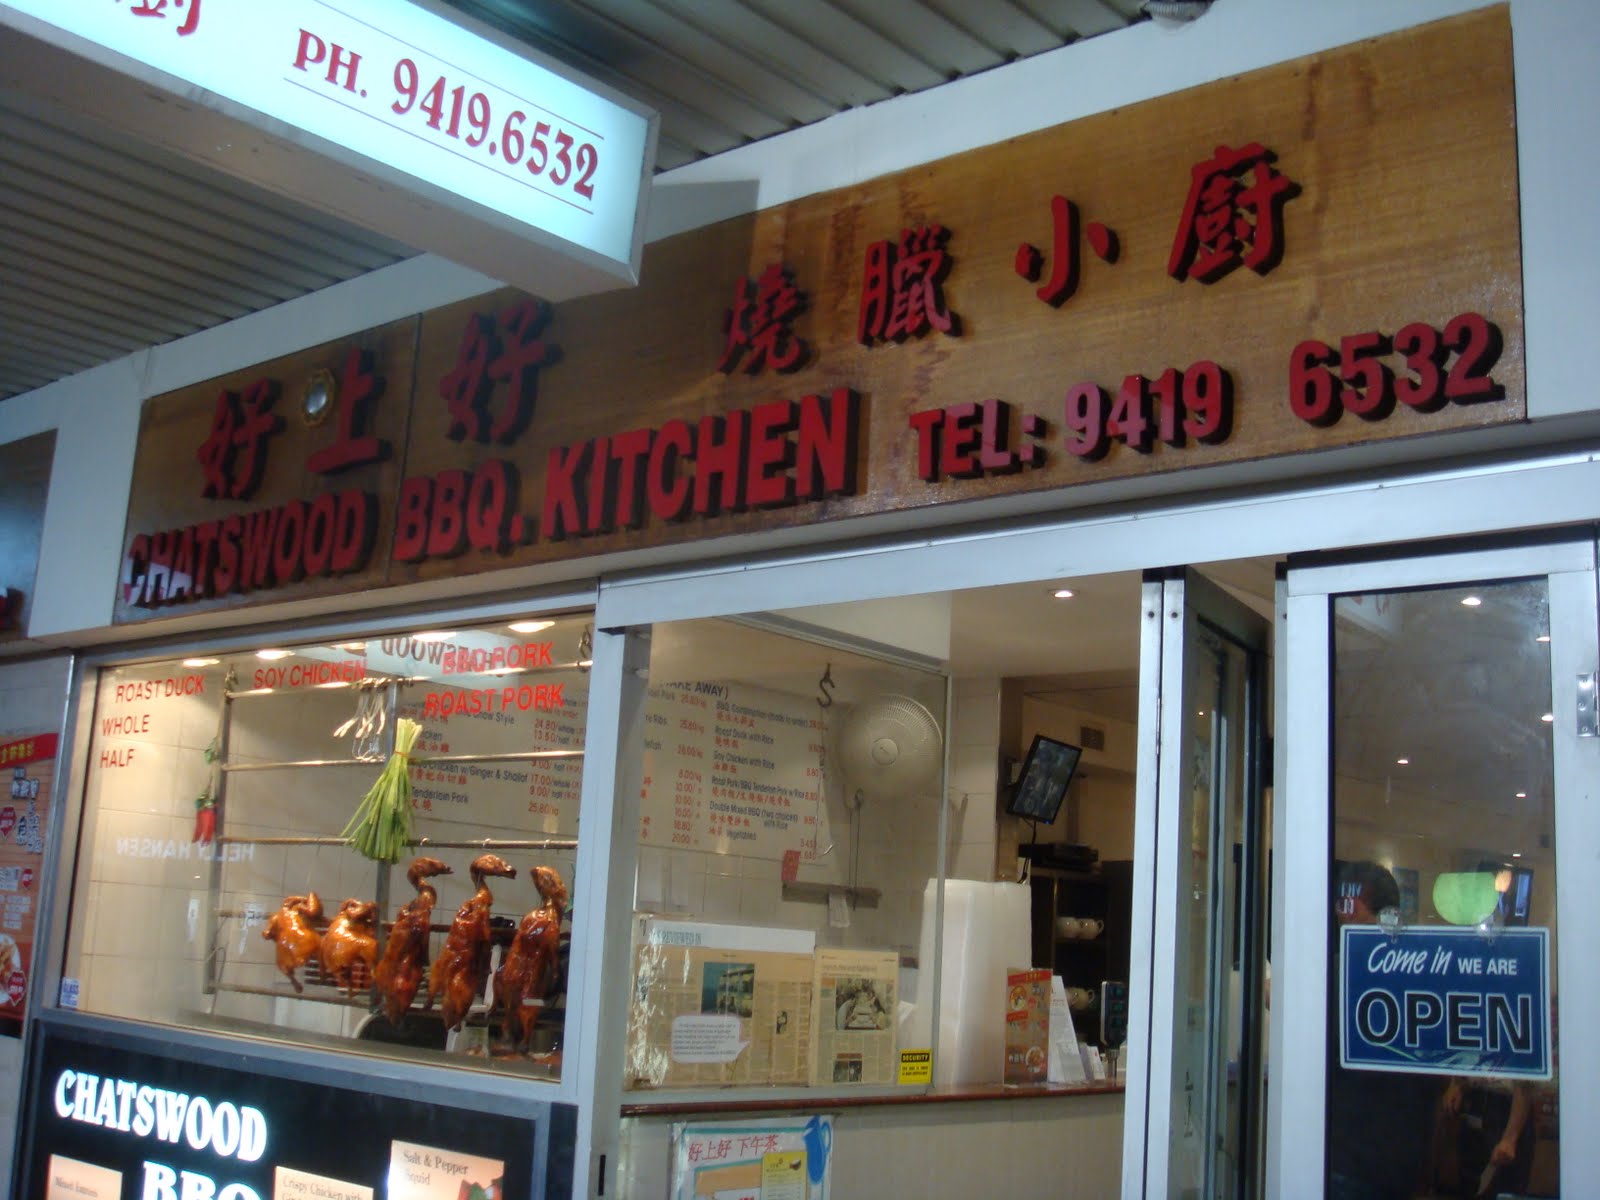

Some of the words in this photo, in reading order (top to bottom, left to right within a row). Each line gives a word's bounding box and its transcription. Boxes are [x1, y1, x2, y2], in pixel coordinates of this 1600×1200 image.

[292, 28, 367, 98] PH.
[391, 58, 599, 200] 9419.6532
[122, 488, 370, 607] CHATSWOOD
[392, 458, 525, 561] BBQ.
[543, 387, 851, 537] KITCHEN
[908, 399, 1038, 480] TEL:
[1064, 360, 1225, 457] 9419
[1288, 311, 1496, 421] 6532
[441, 647, 488, 675] BBQ
[489, 641, 553, 669] PORK
[115, 680, 162, 703] ROAST
[164, 674, 206, 697] DUCK
[253, 668, 287, 689] SOY
[289, 659, 367, 687] CHICKEN
[422, 688, 497, 718] ROAST
[501, 682, 565, 711] PORK
[694, 681, 730, 700] AWAY)
[102, 713, 151, 737] WHOLE
[100, 748, 135, 769] HALF
[1368, 942, 1427, 974] Come
[1430, 945, 1453, 976] in
[1457, 958, 1482, 975] WE
[1486, 958, 1518, 976] ARE
[1355, 987, 1533, 1055] OPEN
[54, 1069, 268, 1163] CHATSWOOD
[403, 1149, 421, 1166] Salt
[423, 1156, 432, 1168] &
[434, 1156, 469, 1176] Pepper
[688, 1138, 732, 1162] 好上好
[737, 1134, 780, 1158] 下午茶
[282, 1174, 307, 1192] Crispy
[310, 1181, 343, 1200] Chicken
